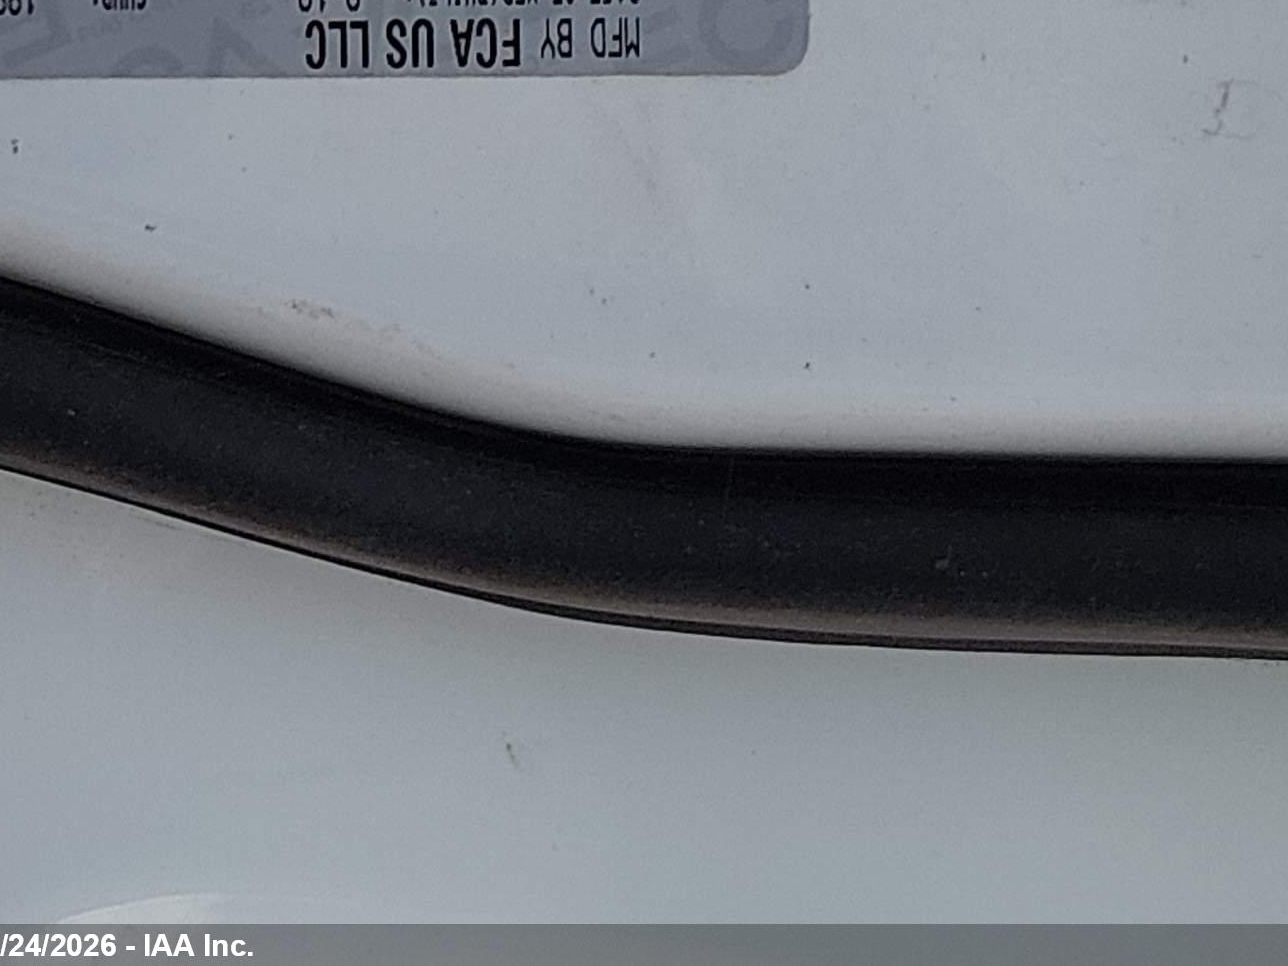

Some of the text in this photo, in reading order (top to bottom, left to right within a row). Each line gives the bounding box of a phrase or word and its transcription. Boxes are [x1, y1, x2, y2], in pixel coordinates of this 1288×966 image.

[305, 17, 640, 69] MFD BY FCA US LLC
